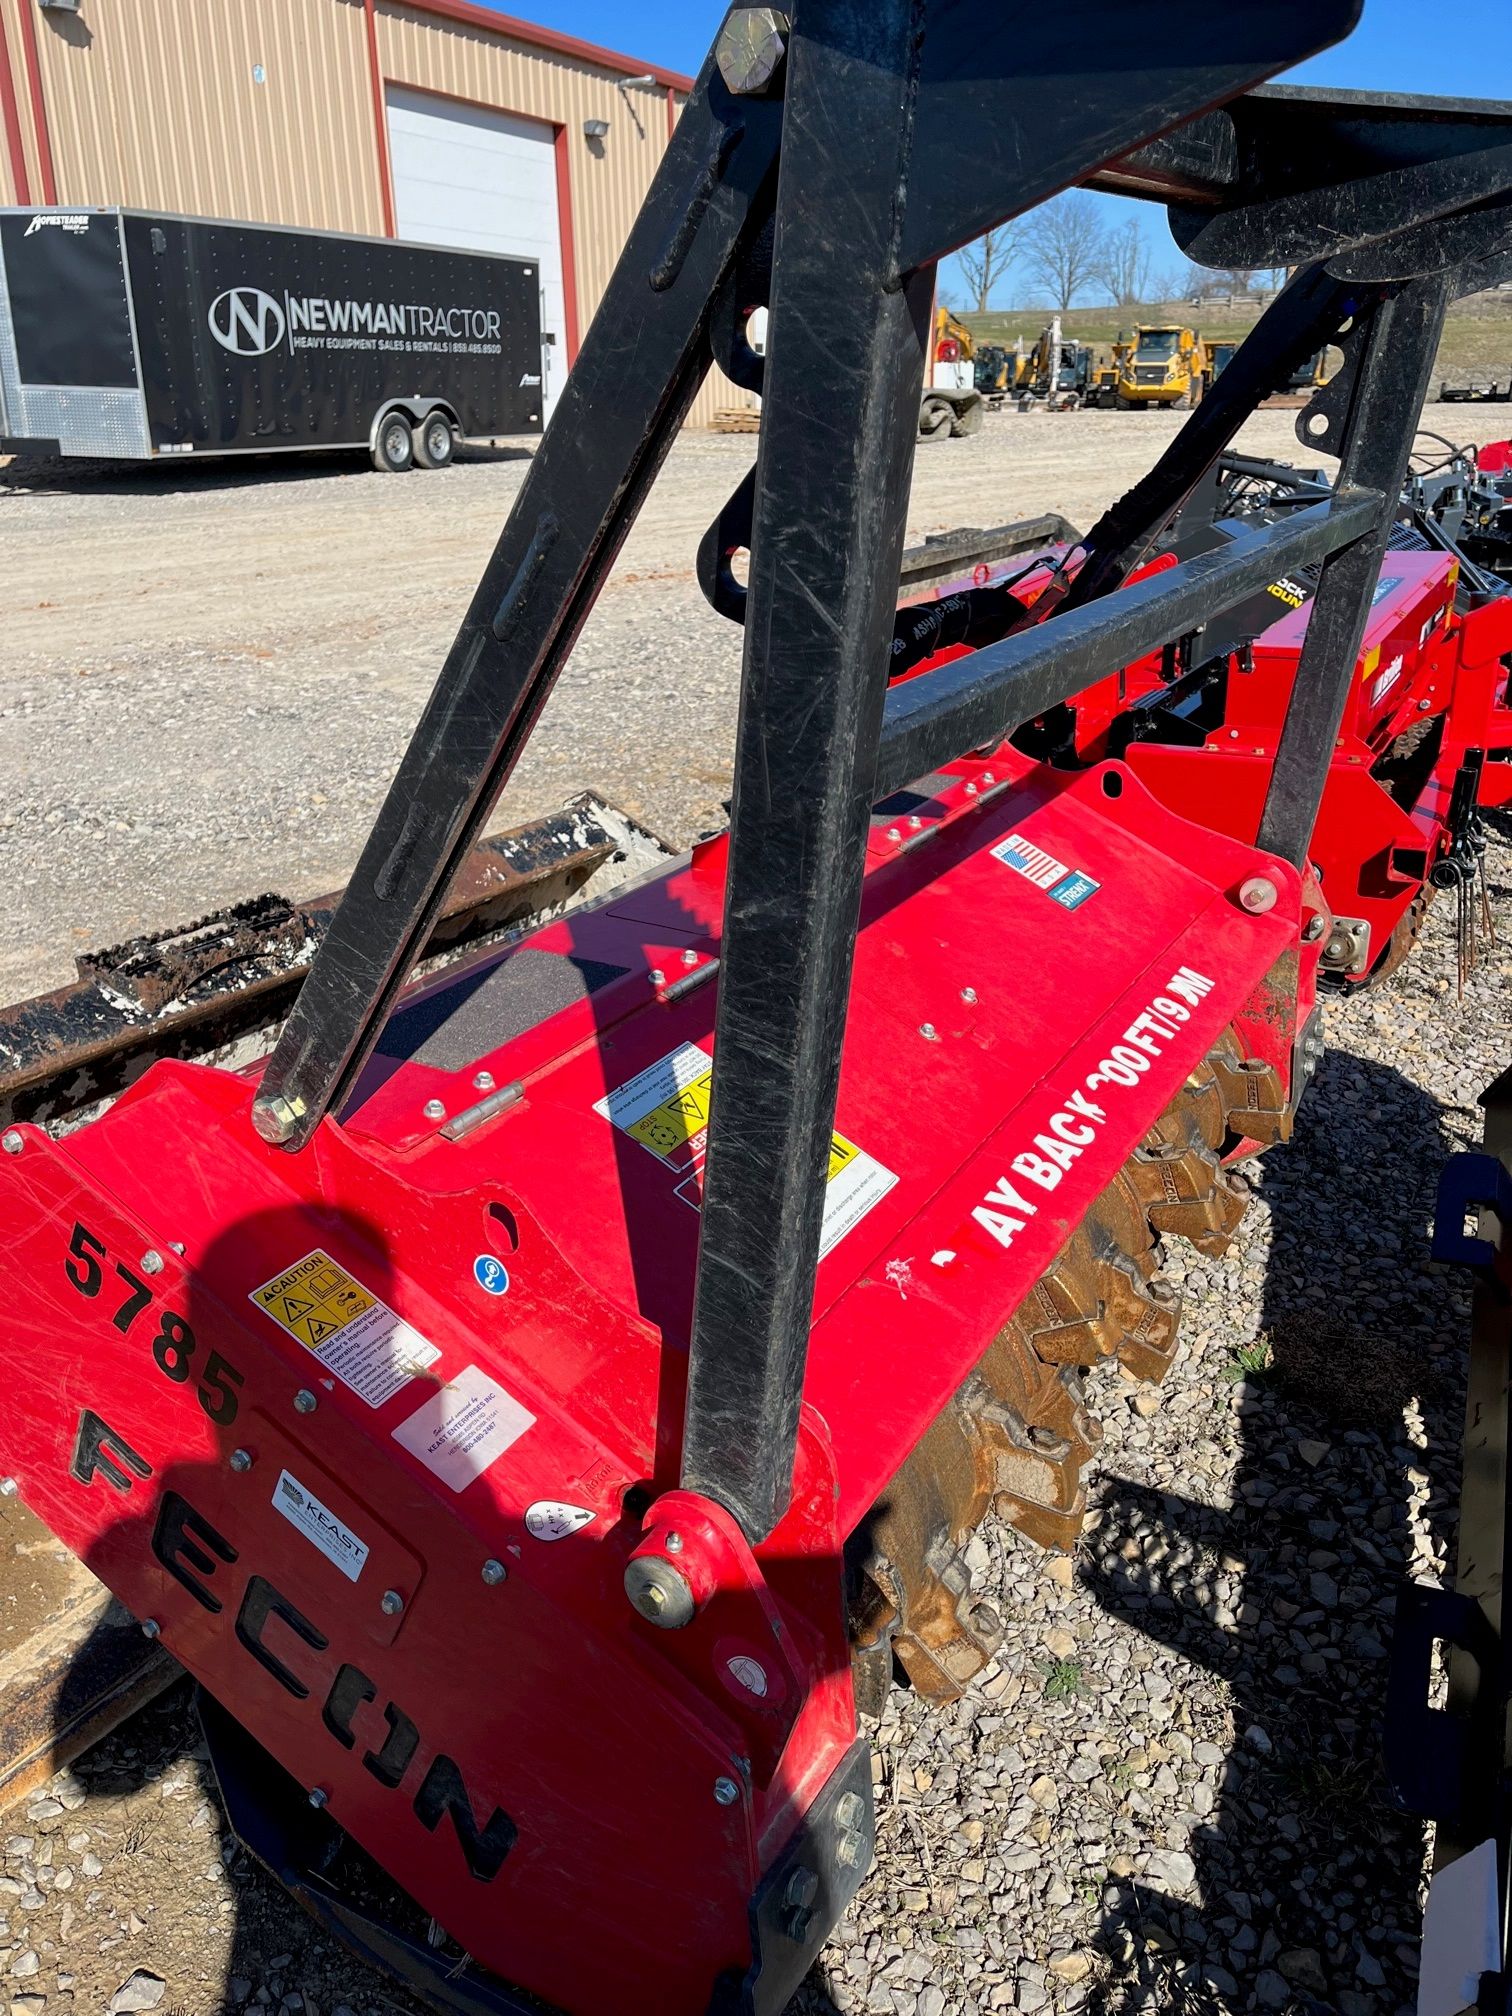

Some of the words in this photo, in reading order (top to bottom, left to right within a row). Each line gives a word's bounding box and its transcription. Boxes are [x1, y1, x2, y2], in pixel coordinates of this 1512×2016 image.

[293, 336, 325, 349] HEAVY
[326, 338, 377, 350] EQUIPMENT
[378, 339, 404, 351] SALES
[413, 341, 449, 353] RENTALS
[637, 1114, 657, 1131] STOP
[1010, 1089, 1106, 1191] BACK
[270, 1255, 323, 1296] CAUTION
[64, 1221, 246, 1427] 5785
[316, 1338, 335, 1354] Read
[332, 1329, 346, 1342] and
[344, 1306, 379, 1333] understand
[322, 1338, 349, 1360] owner's
[346, 1323, 370, 1342] manual
[368, 1309, 388, 1326] before
[336, 1355, 356, 1371] Periodic
[354, 1335, 383, 1357] maintenance
[348, 1359, 362, 1371] bolts
[360, 1348, 378, 1363] require
[375, 1334, 395, 1351] periodic
[358, 1368, 389, 1391] maintenance
[364, 1382, 382, 1397] Failure
[369, 1381, 396, 1402] equipment
[426, 1433, 449, 1453] KEAST
[445, 1400, 487, 1436] ENTERPRISES
[483, 1391, 496, 1403] INC
[446, 1429, 477, 1456] HENDERSON
[306, 1501, 364, 1556] KEAST
[70, 1408, 519, 1882] FECON
